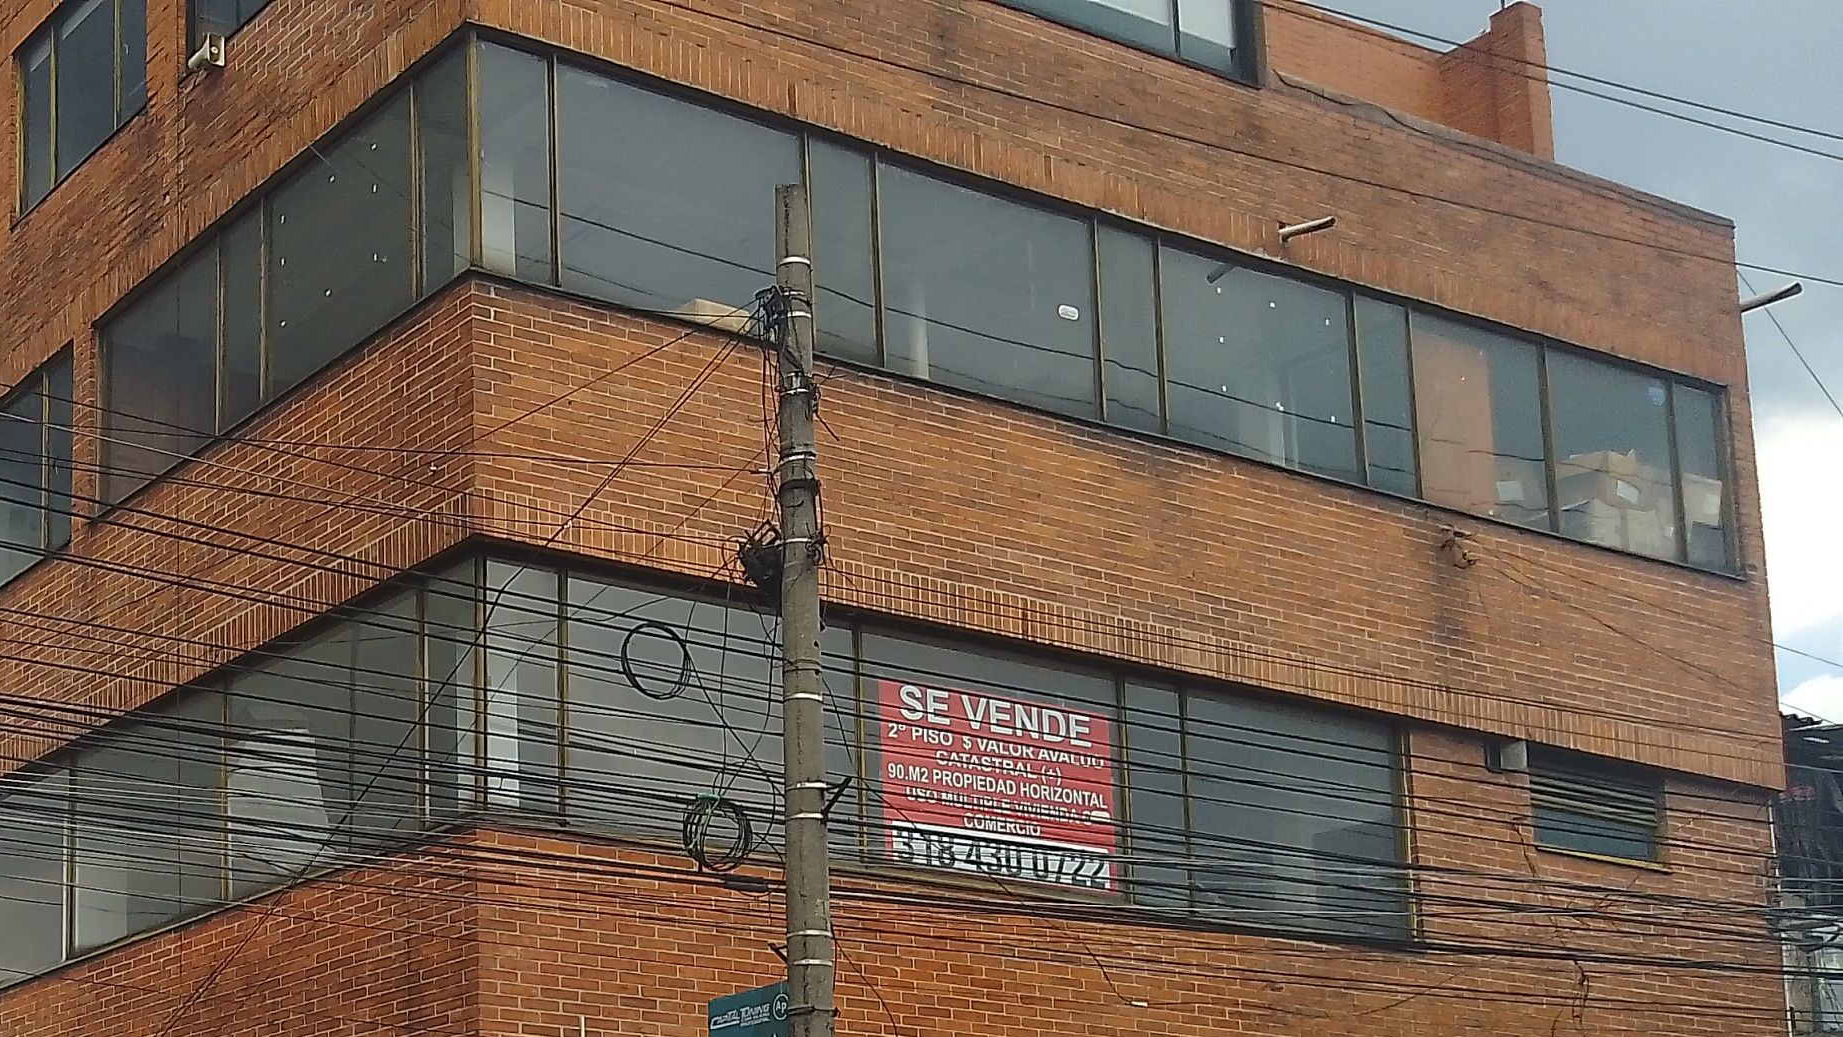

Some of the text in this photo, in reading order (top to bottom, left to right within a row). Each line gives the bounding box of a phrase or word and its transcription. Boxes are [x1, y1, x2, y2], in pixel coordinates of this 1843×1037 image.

[899, 684, 1093, 748] SE VENDE
[911, 726, 953, 746] PISO
[962, 735, 972, 751] $
[977, 738, 1034, 759] VALOR
[936, 750, 1037, 779] CATASTRAL
[888, 763, 1108, 809] 90.M2 PROPIEDAD HORIZONTAL
[906, 786, 937, 804] USO
[964, 812, 1041, 836] COMERCIO
